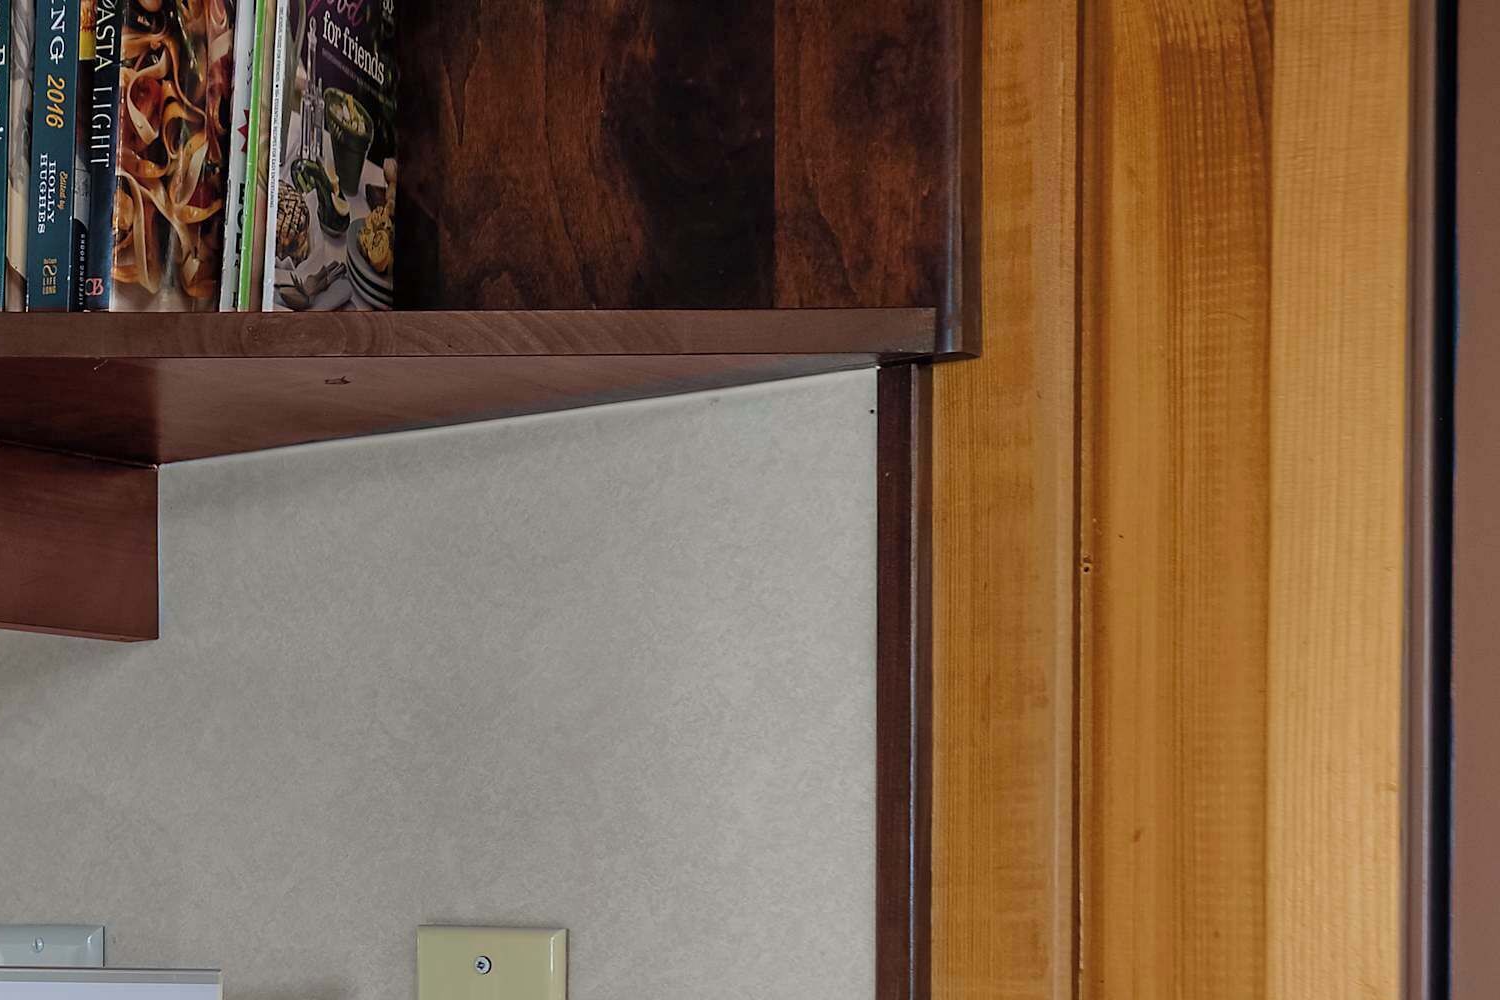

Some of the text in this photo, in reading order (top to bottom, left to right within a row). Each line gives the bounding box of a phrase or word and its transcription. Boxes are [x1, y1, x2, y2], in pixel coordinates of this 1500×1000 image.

[322, 10, 342, 48] for
[342, 27, 385, 85] friends
[46, 74, 66, 129] 2016
[90, 86, 113, 168] LIGHT
[38, 153, 48, 234] HUGHES
[46, 160, 57, 223] HOLLY
[59, 171, 69, 195] Edited
